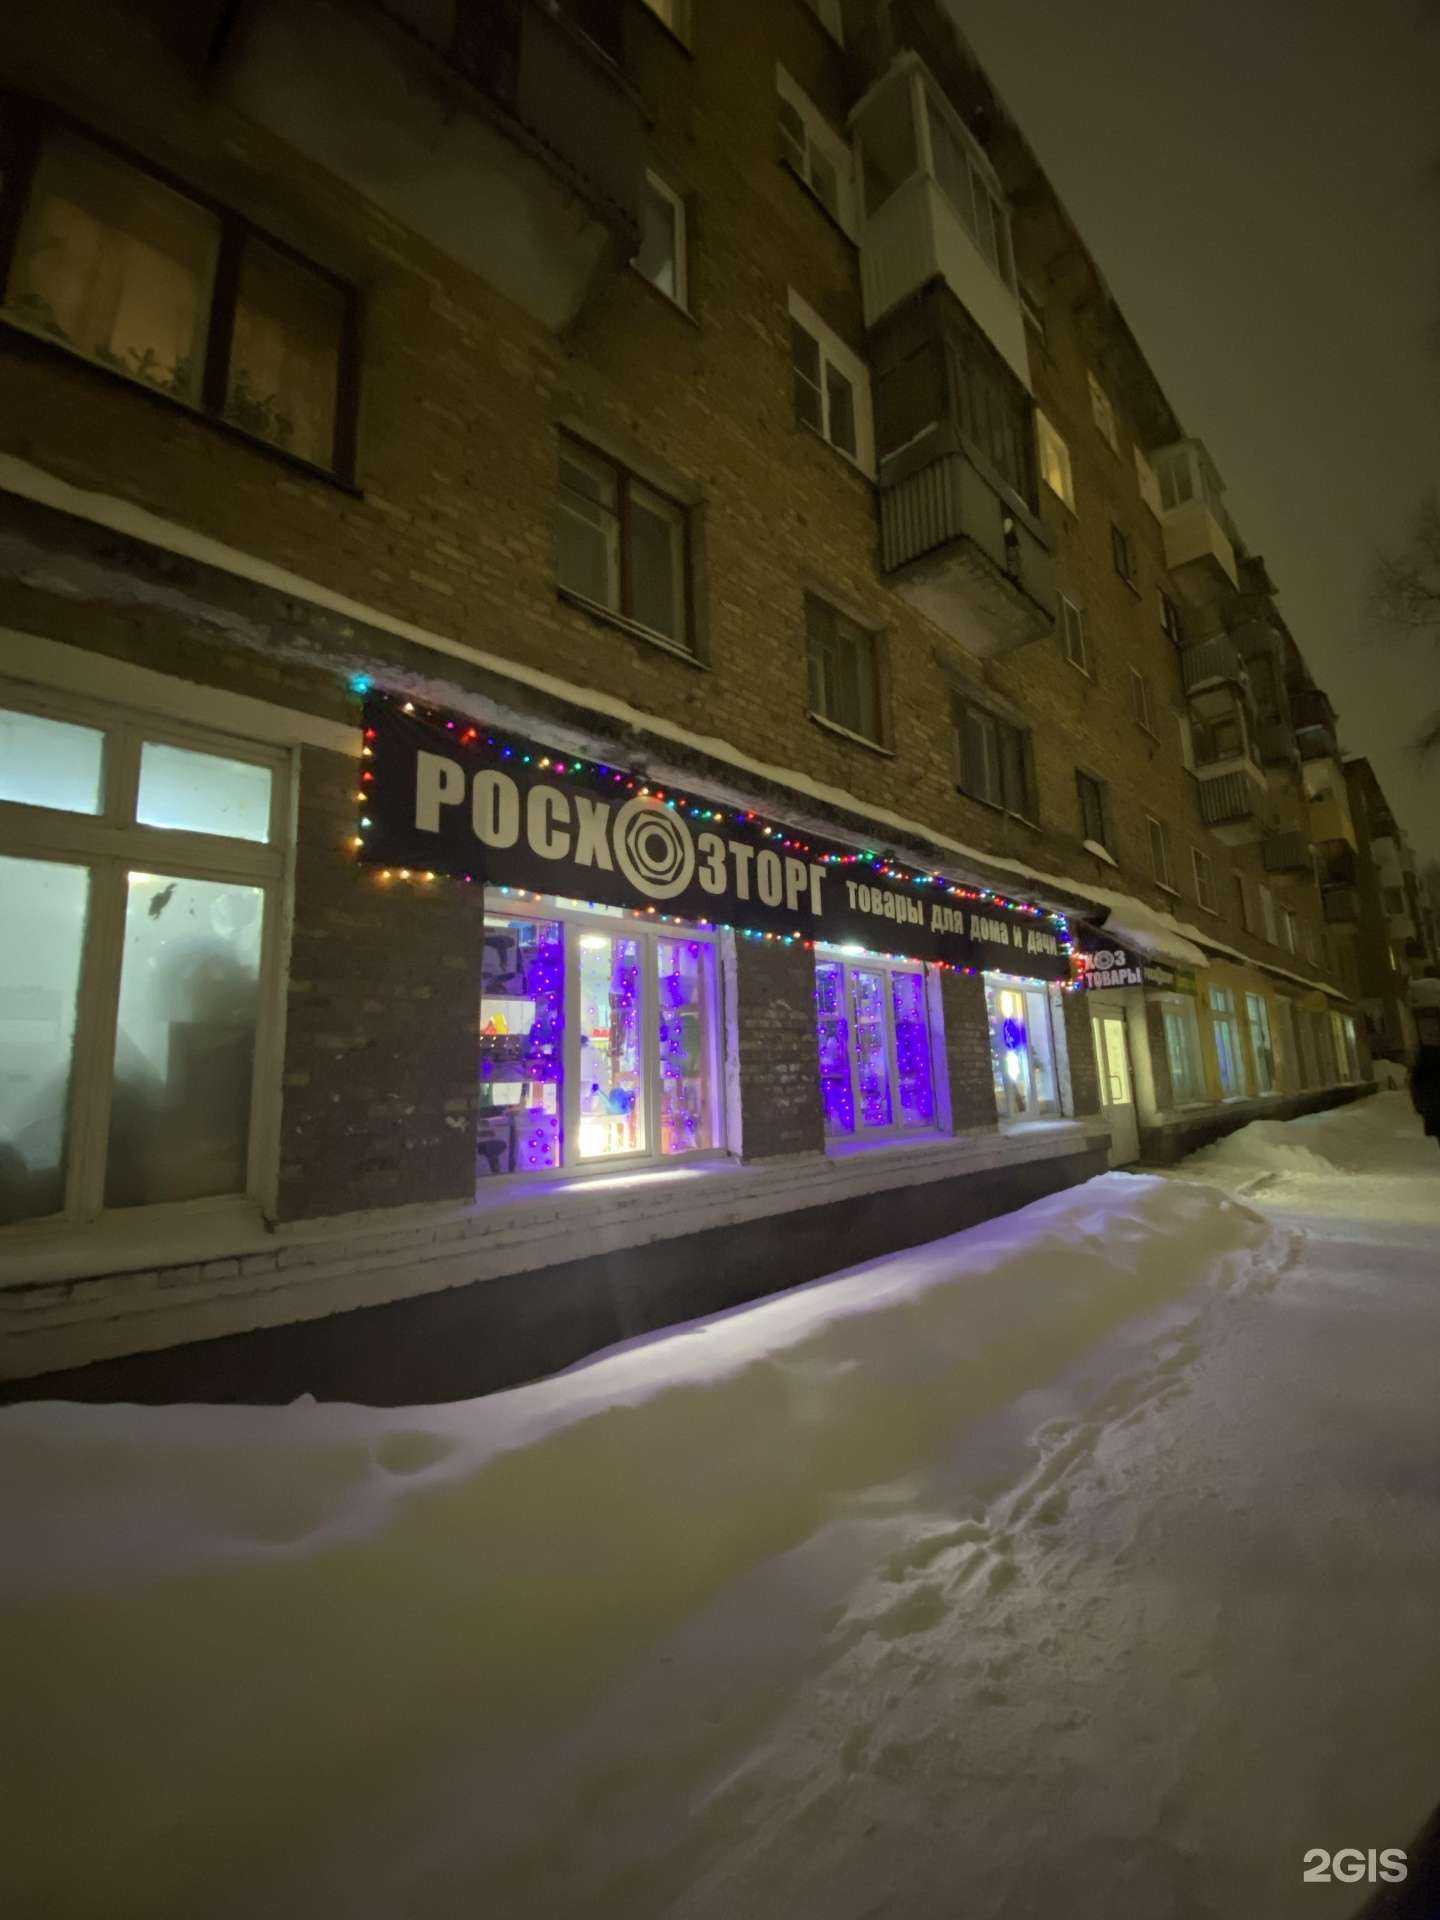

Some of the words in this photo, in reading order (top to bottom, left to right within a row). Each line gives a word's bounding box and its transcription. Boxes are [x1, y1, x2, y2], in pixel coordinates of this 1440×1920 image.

[931, 904, 964, 935] для
[970, 915, 1009, 944] дома
[1012, 924, 1023, 948] и
[1086, 967, 1142, 988] ТОВАРЫ
